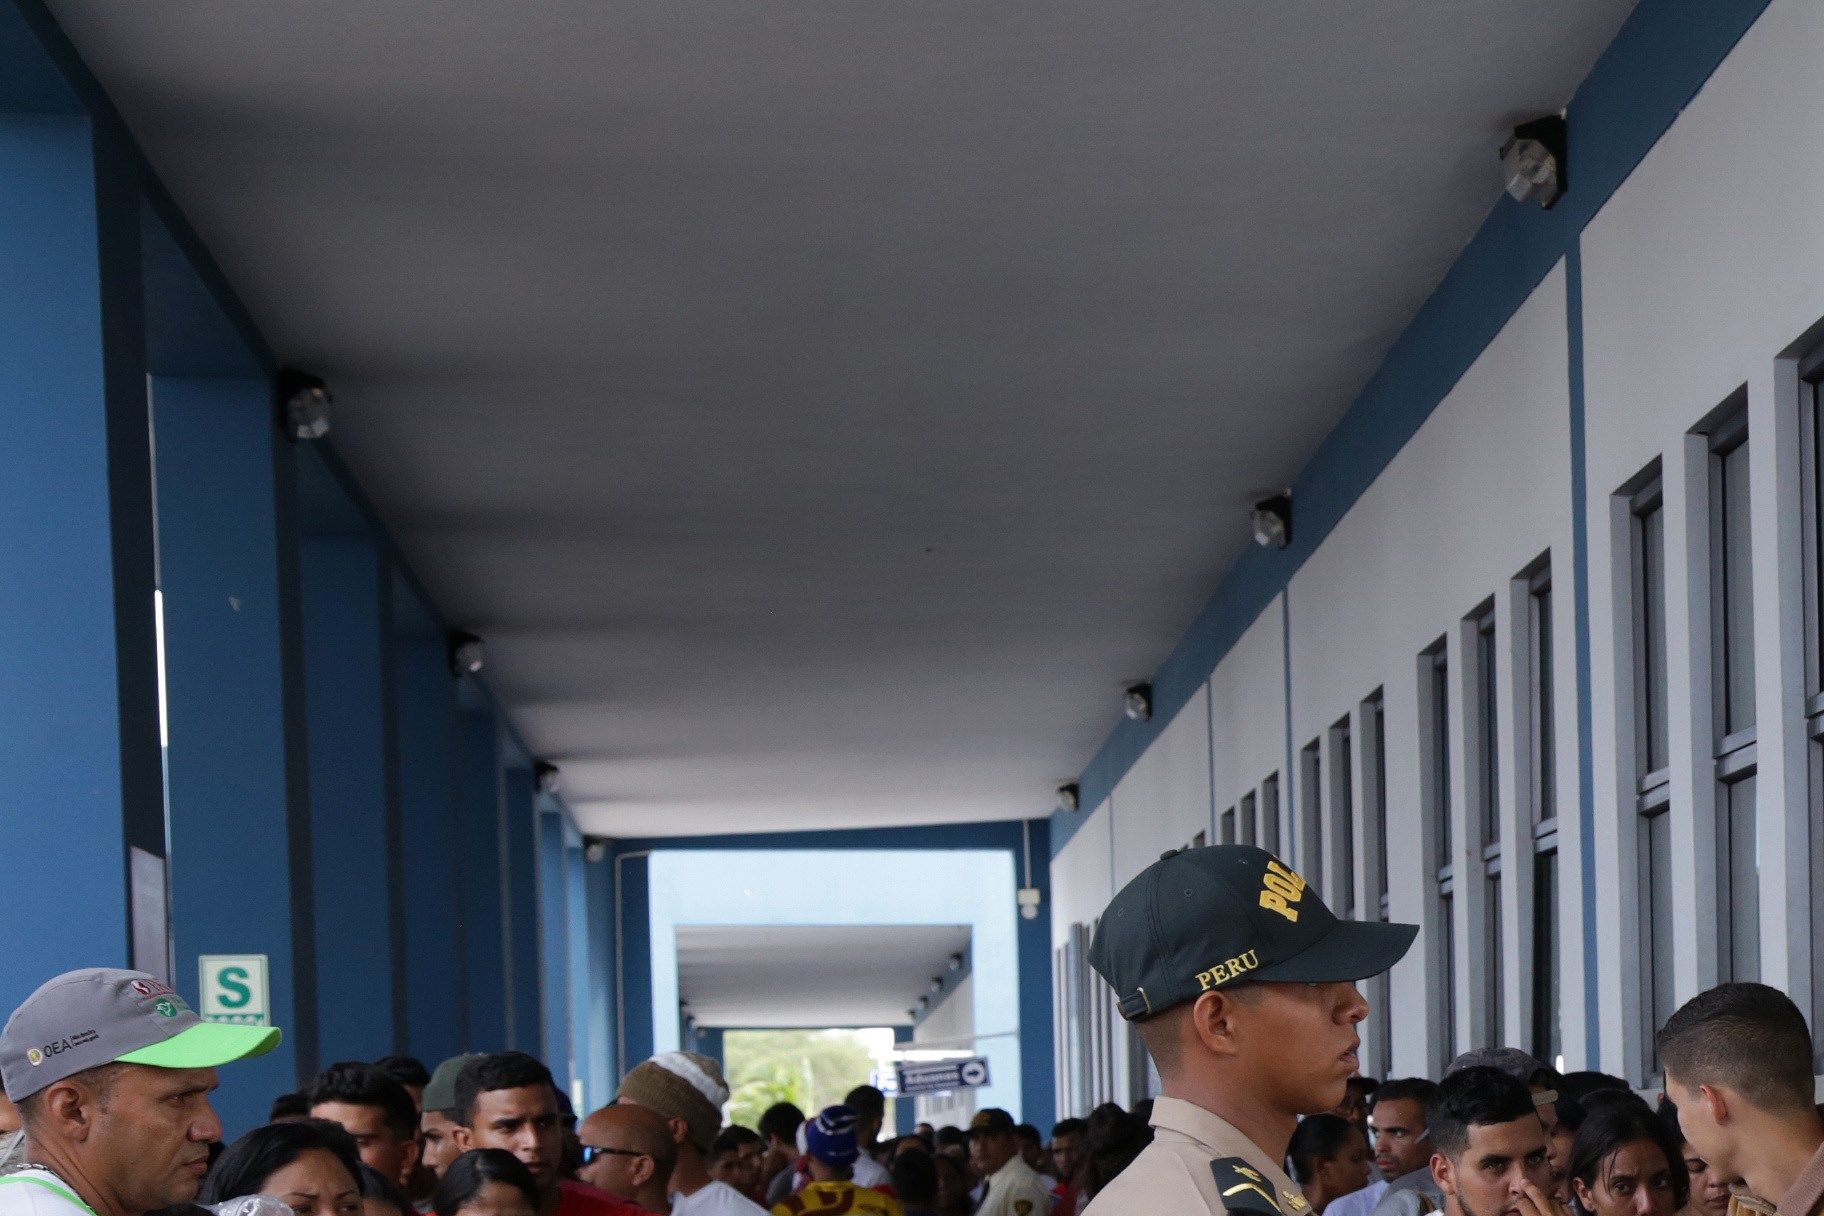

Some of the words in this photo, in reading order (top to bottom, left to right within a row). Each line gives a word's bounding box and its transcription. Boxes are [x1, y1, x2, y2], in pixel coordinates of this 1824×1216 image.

[217, 966, 252, 1009] S
[1194, 949, 1259, 991] PERU
[43, 1038, 72, 1058] OEA
